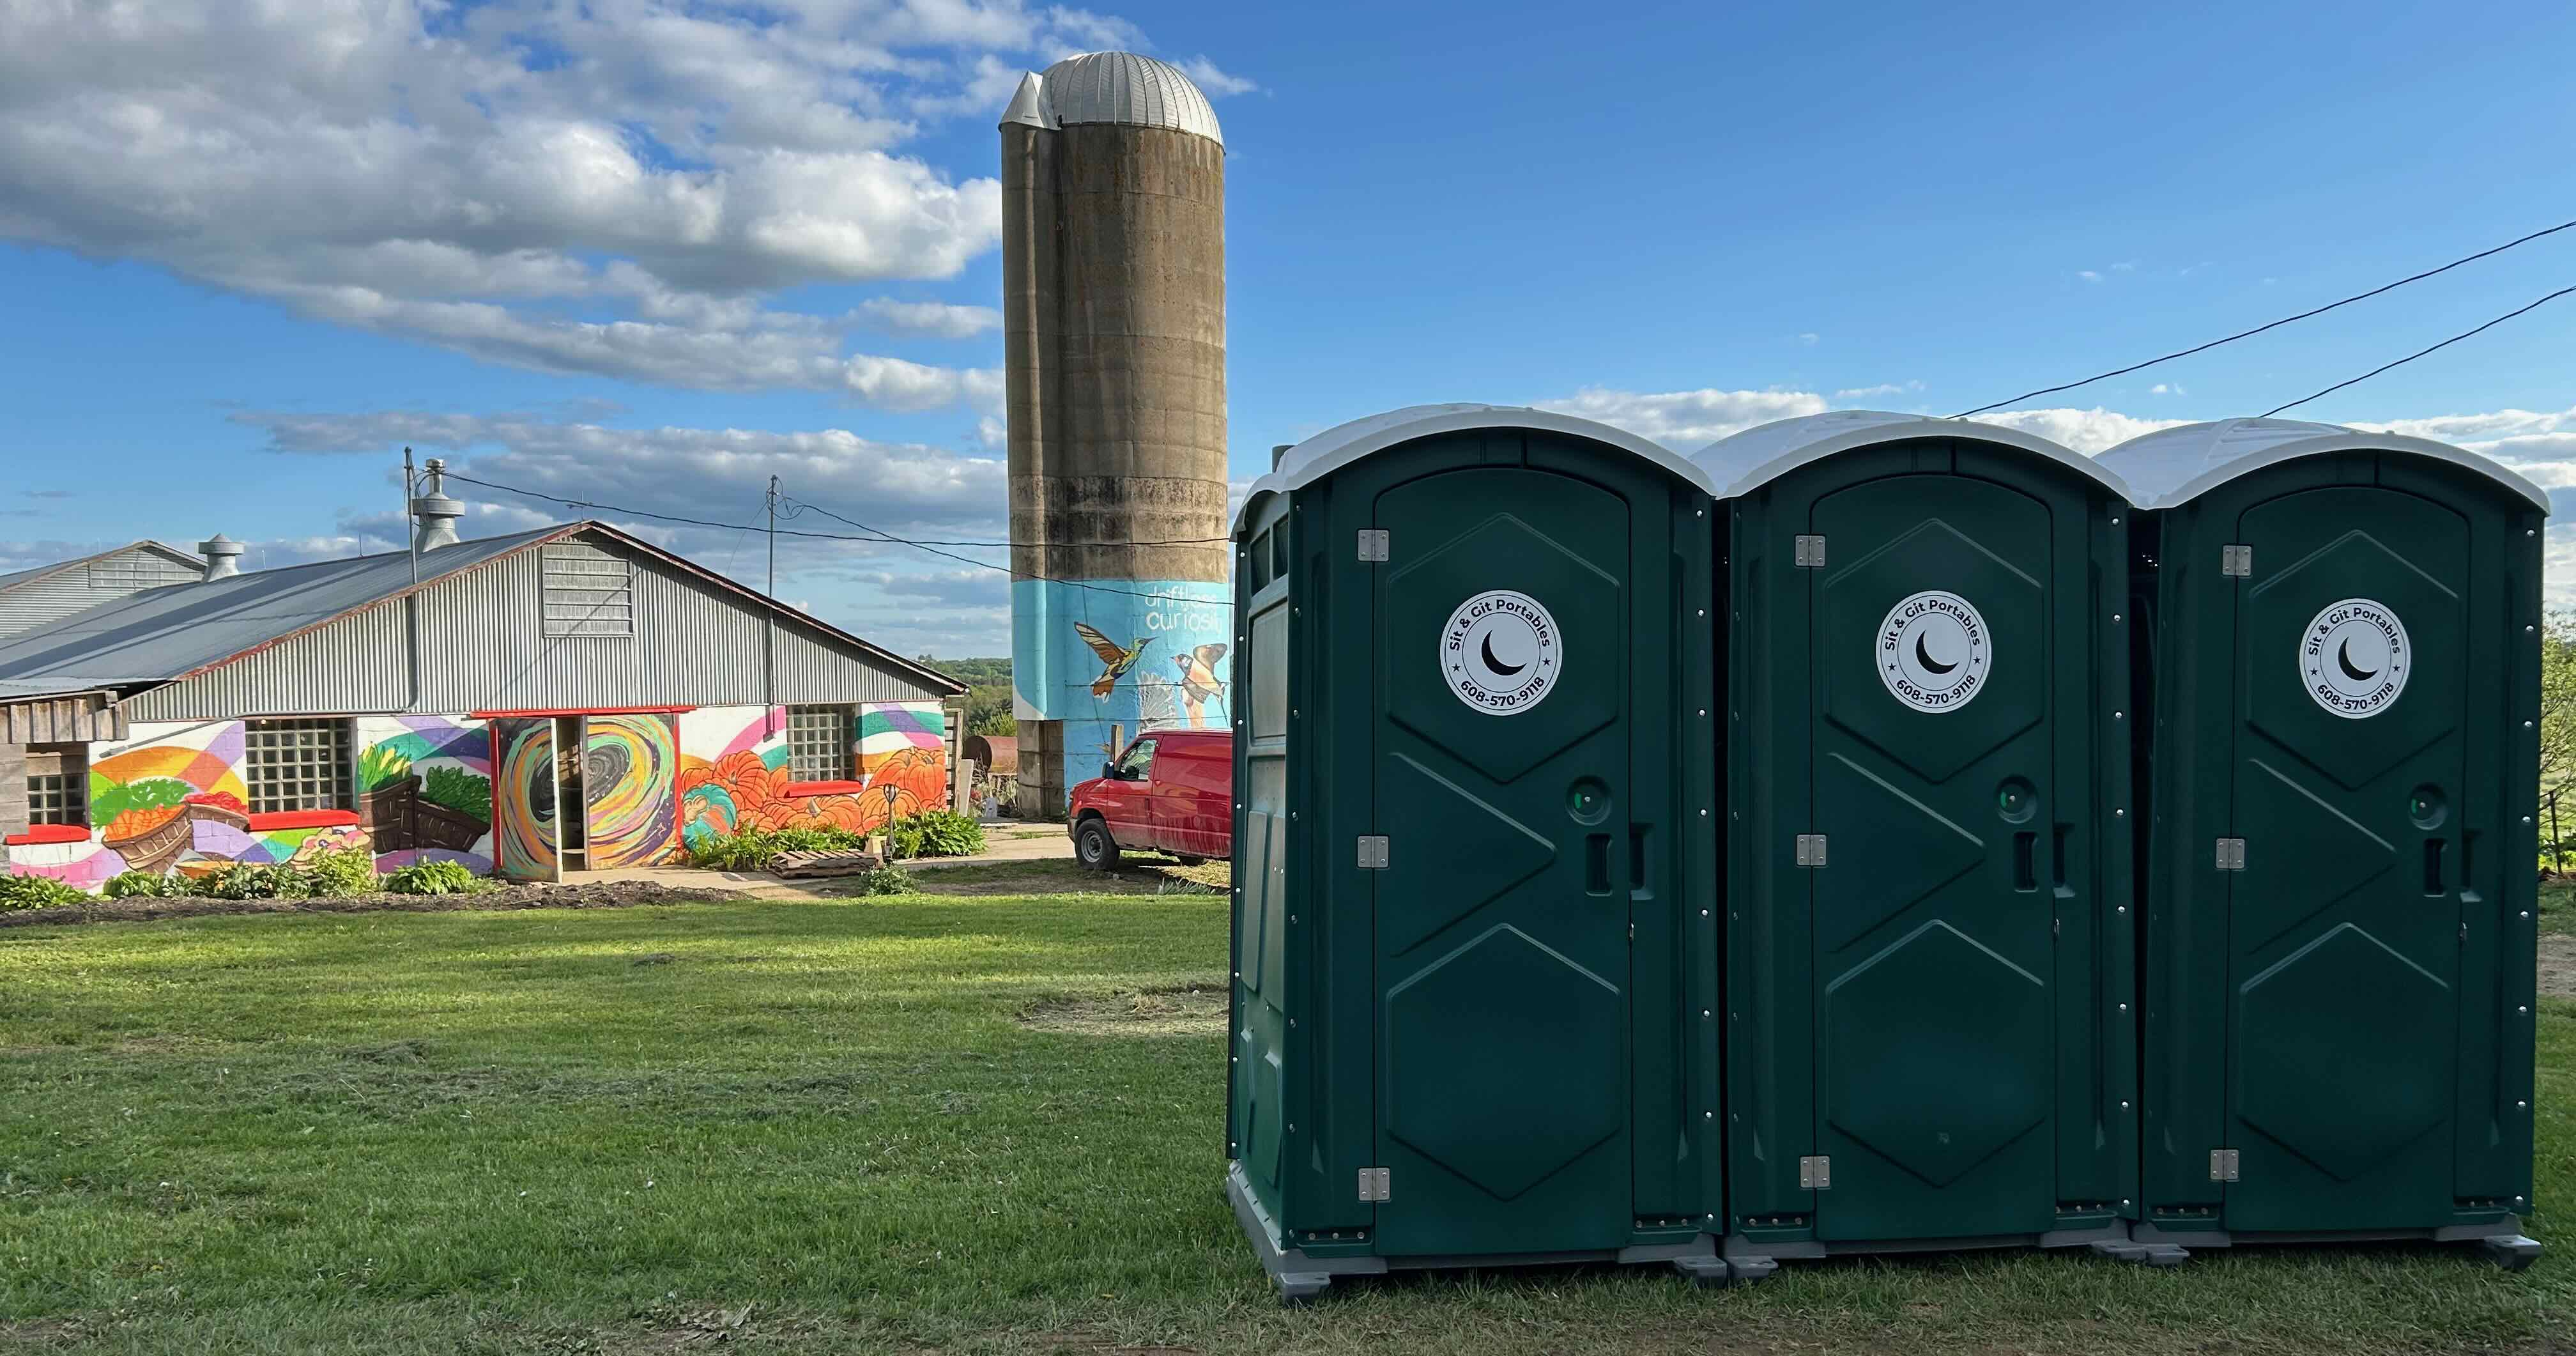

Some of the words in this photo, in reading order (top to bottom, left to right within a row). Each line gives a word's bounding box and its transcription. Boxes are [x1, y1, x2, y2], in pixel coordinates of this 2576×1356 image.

[1450, 631, 1464, 651] Sit
[1459, 618, 1471, 628] &
[1471, 602, 1492, 617] Git
[1496, 599, 1550, 647] Portables
[1885, 631, 1899, 651] Sit
[1894, 619, 1905, 628] &
[1905, 602, 1926, 618] Git
[1929, 599, 1980, 645] Portables
[2308, 636, 2322, 656] Sit
[2319, 624, 2329, 635] &
[2329, 610, 2350, 624] Git
[2353, 607, 2400, 654] Portables
[1461, 677, 1544, 706] 608-570-9118
[1896, 675, 1975, 704] 608-570-9118
[2317, 682, 2394, 710] 608-570-9118
